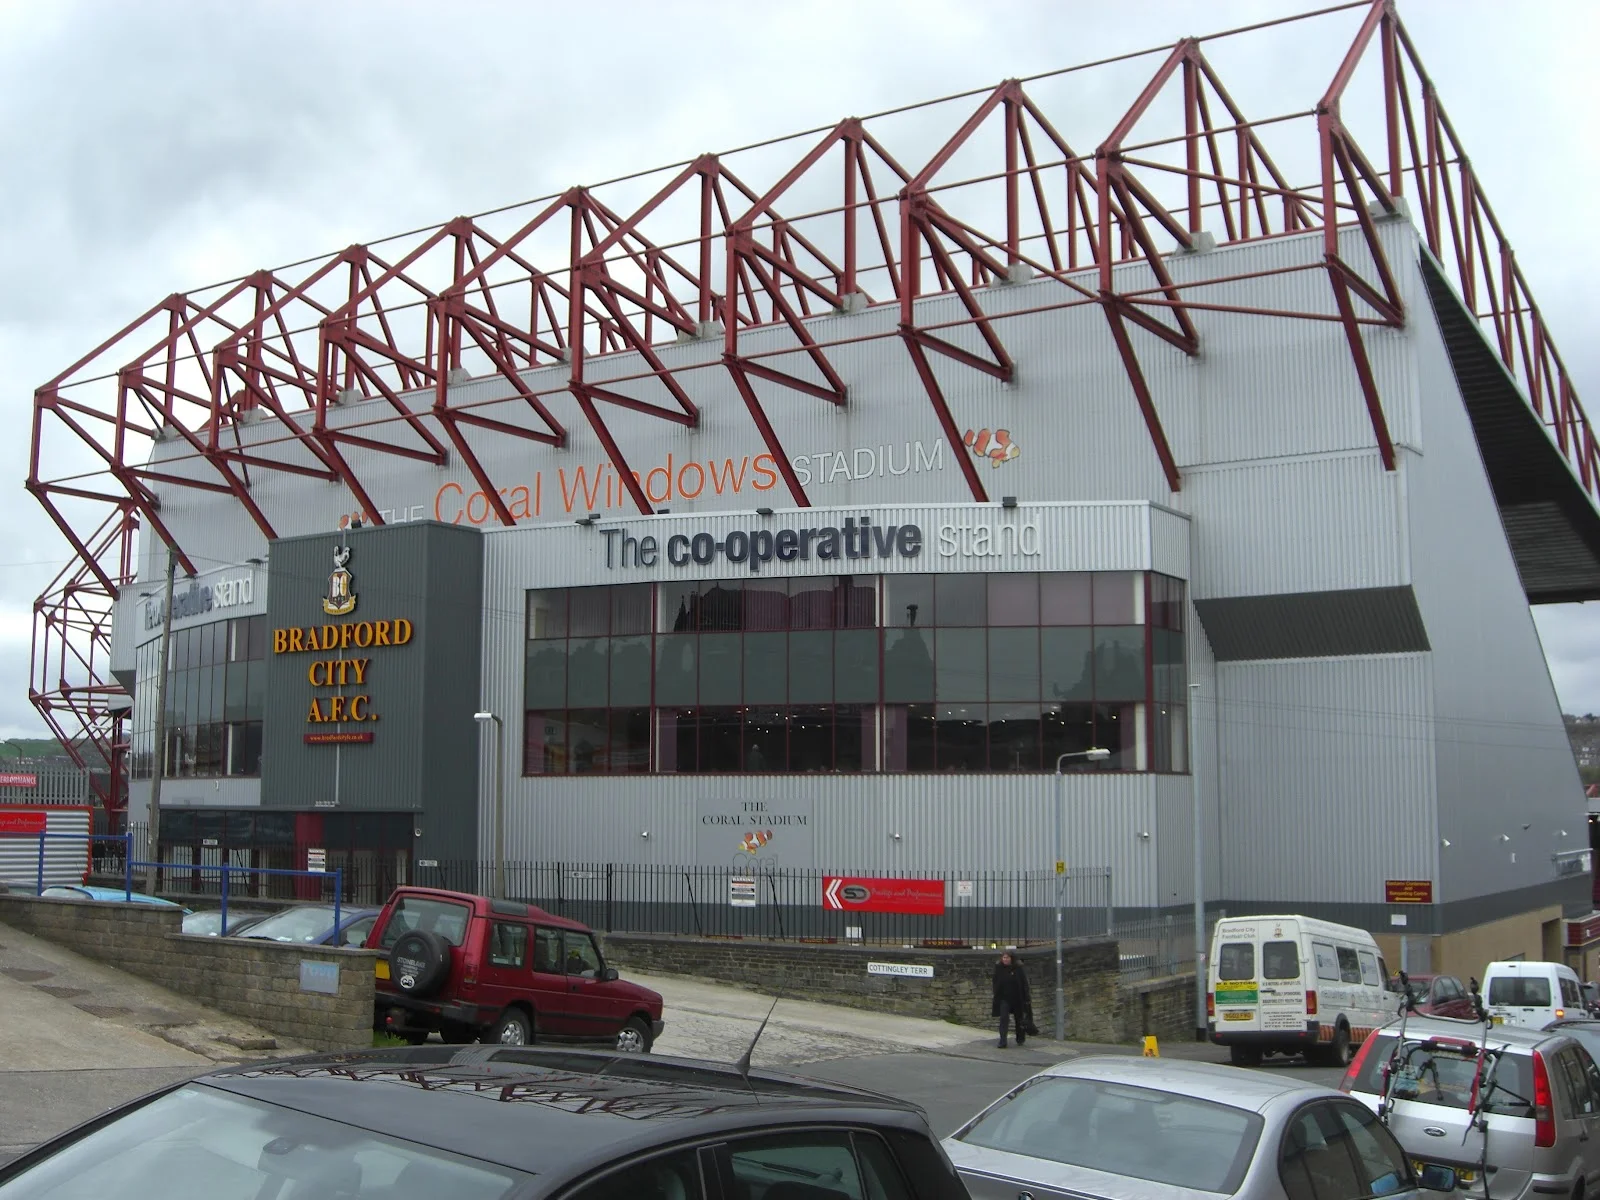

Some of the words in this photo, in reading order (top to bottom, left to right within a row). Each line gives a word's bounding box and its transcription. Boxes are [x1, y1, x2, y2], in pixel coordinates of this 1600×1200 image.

[435, 471, 541, 526] Coral
[558, 453, 778, 513] Windows
[791, 438, 944, 487] STADIUM
[599, 528, 658, 569] The
[667, 516, 922, 572] co-operative
[939, 512, 1041, 557] stand
[214, 569, 254, 609] stand
[273, 618, 413, 654] BRADFORD
[308, 658, 370, 687] CITY
[307, 695, 379, 723] A.F.C.
[0, 775, 36, 784] ERFORMANCE
[702, 815, 744, 825] CORAL
[750, 815, 807, 825] STADIUM
[741, 802, 768, 812] THE
[869, 964, 909, 974] COTTINGLEY
[911, 966, 928, 975] TERR
